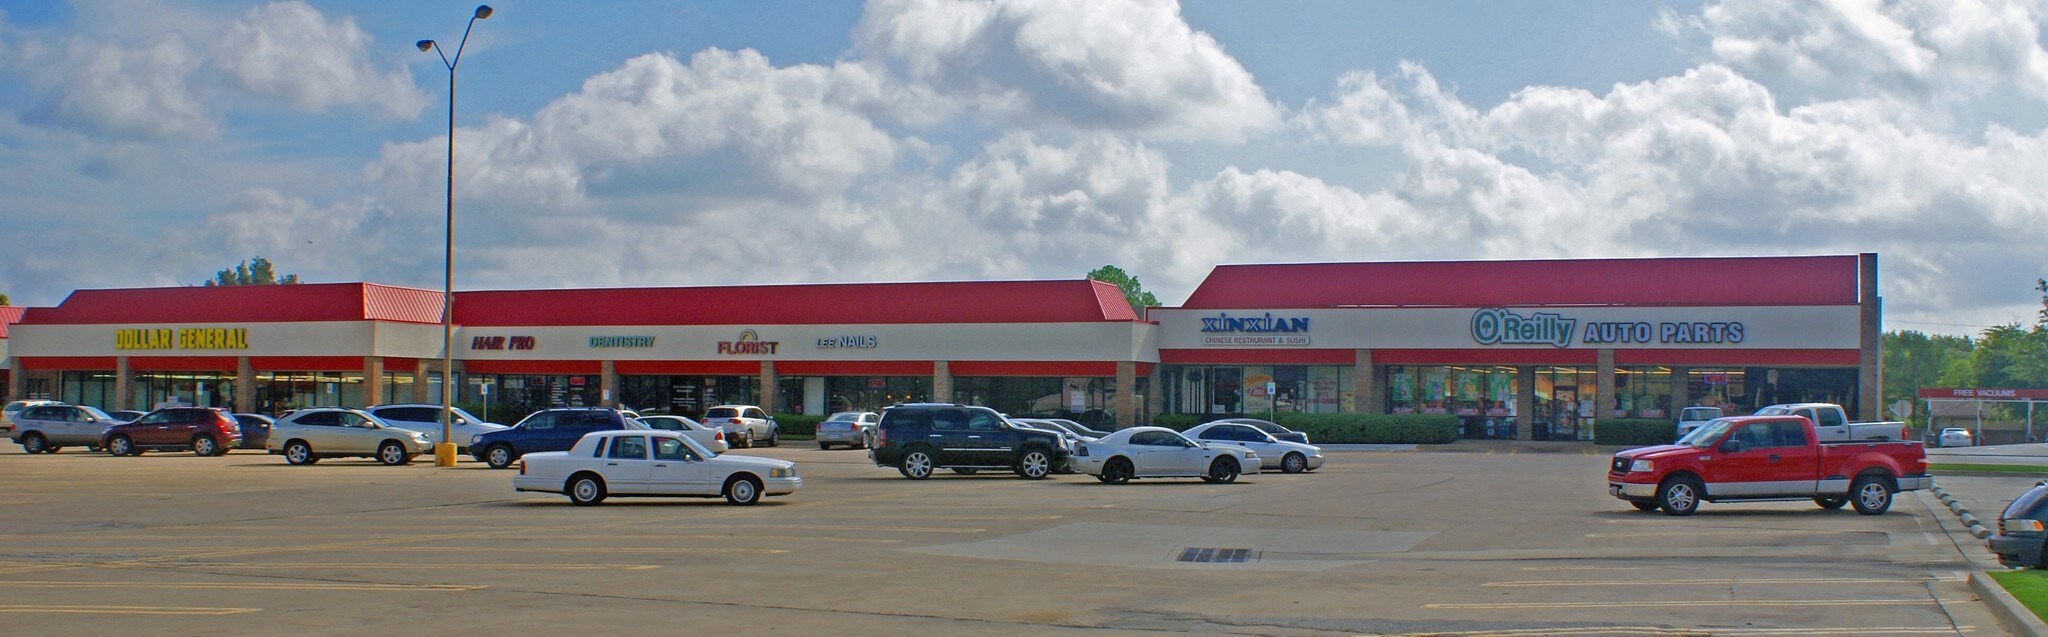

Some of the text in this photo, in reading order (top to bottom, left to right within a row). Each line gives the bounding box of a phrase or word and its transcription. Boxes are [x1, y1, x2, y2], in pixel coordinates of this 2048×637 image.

[1472, 309, 1743, 346] O'Reilly AUTO PARTS
[115, 328, 248, 349] DOLLAR GENERAL
[471, 336, 536, 350] HAIR PRO
[589, 335, 656, 348] DENTISTRY
[816, 335, 877, 348] LEE NAILS
[717, 341, 779, 355] FLORIST
[1953, 389, 2016, 397] FREE VACUUMS
